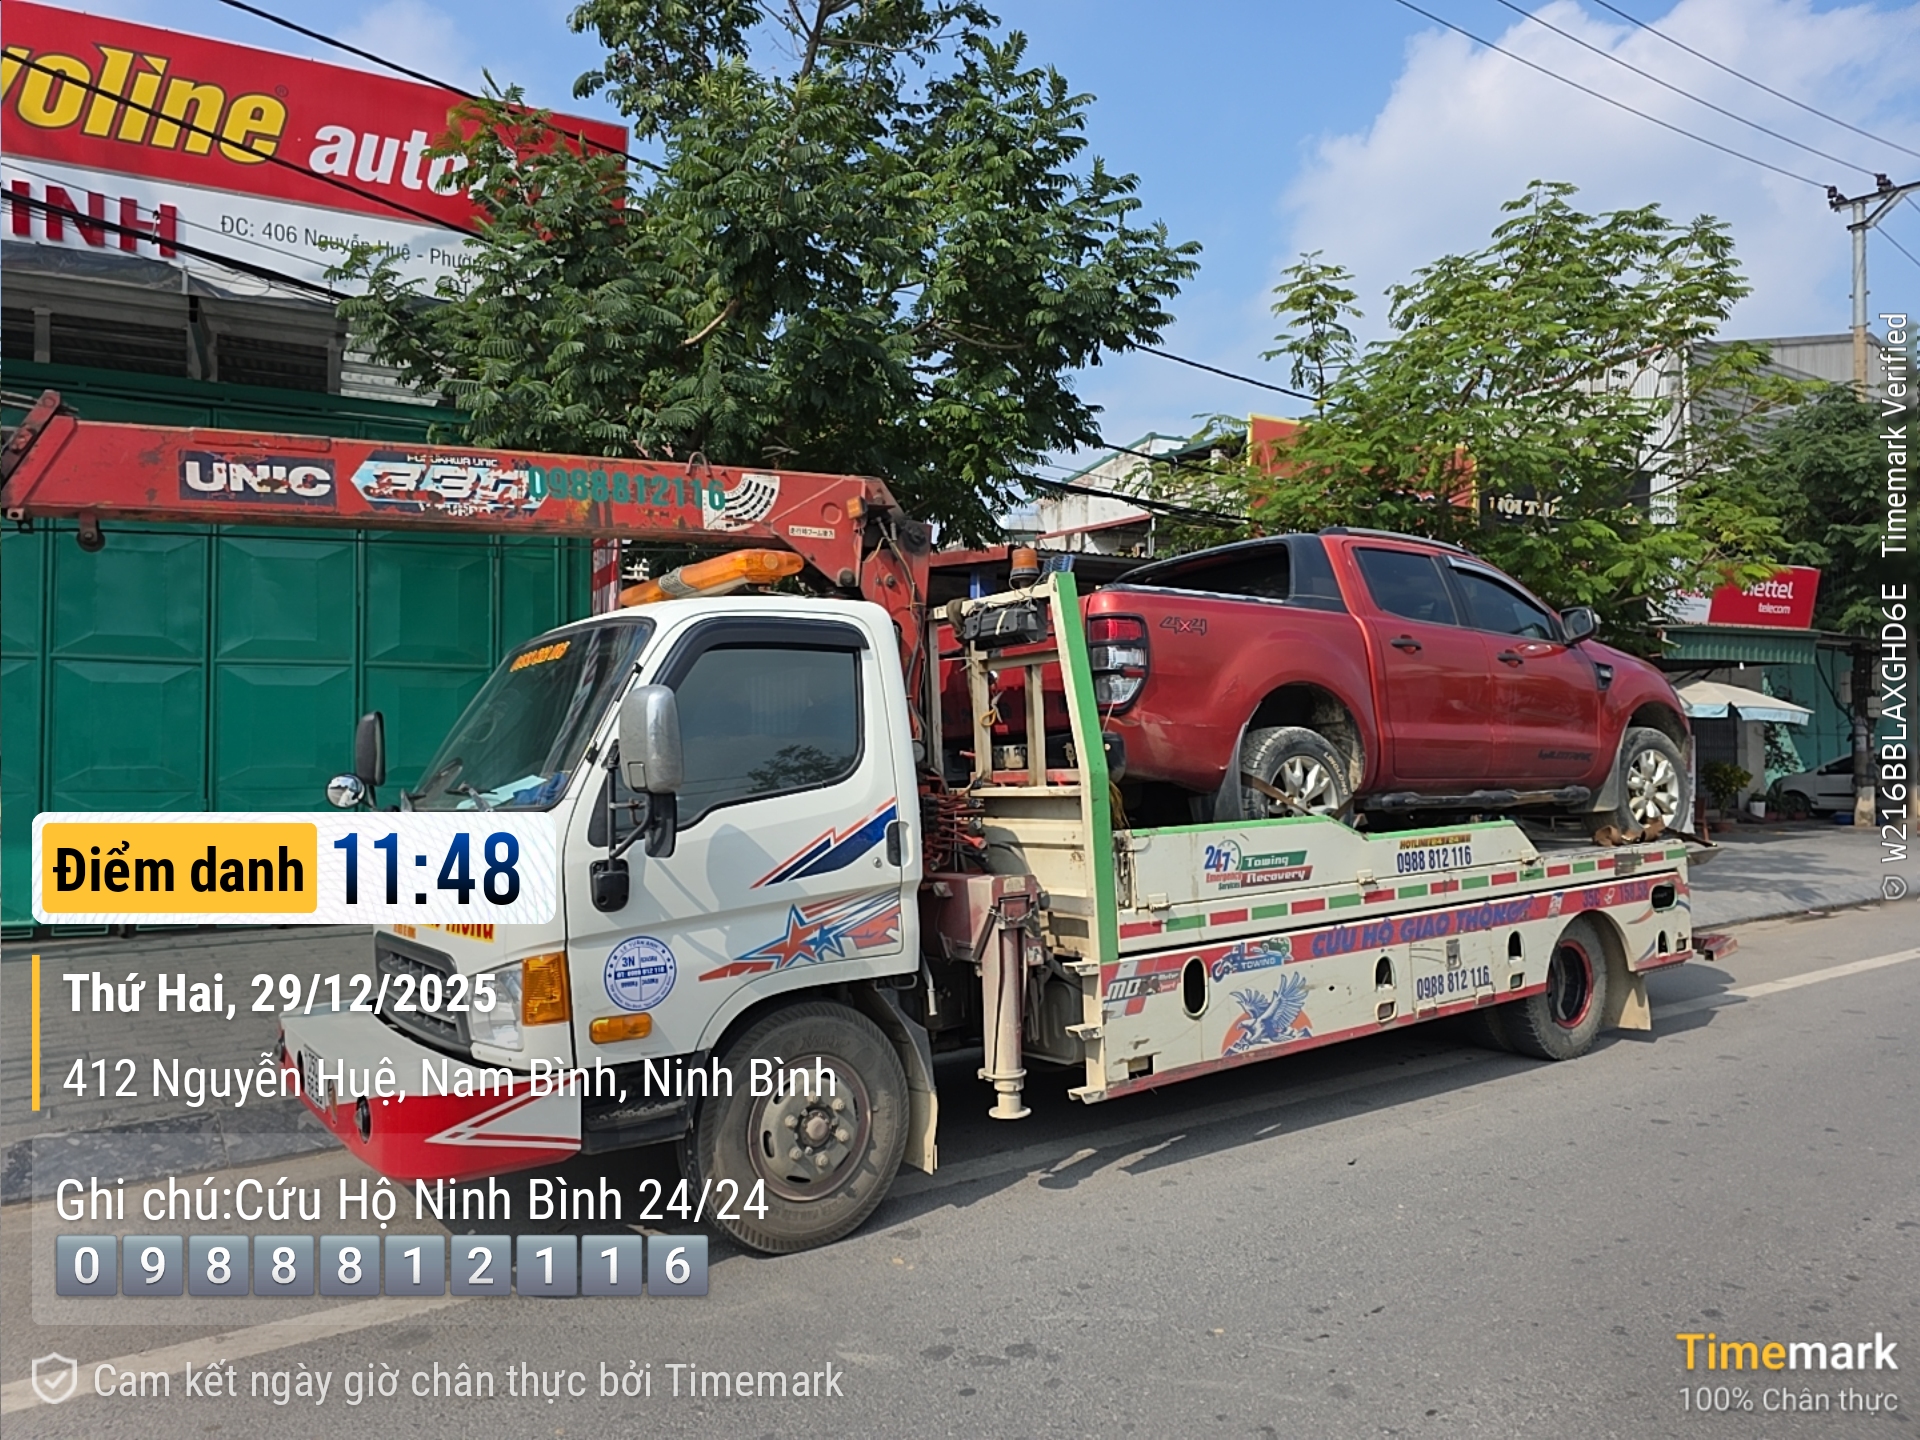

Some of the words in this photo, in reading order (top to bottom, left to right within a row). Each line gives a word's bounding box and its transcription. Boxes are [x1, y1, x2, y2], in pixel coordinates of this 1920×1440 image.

[220, 214, 254, 238] ĐC:
[262, 222, 298, 244] 406
[185, 460, 331, 497] UNIC
[528, 465, 726, 511] 0988812116
[1741, 580, 1794, 599] iettel
[1758, 602, 1791, 615] telecom
[1245, 855, 1289, 867] Towing
[1397, 850, 1425, 873] 0988
[1428, 848, 1449, 869] 812
[1451, 845, 1471, 866] 116
[1246, 870, 1306, 884] Recovery
[1400, 913, 1448, 942] GIAO
[1241, 957, 1275, 969] TOWING
[1416, 974, 1445, 1000] 0988
[1447, 970, 1468, 992] 812
[1470, 965, 1490, 987] 116
